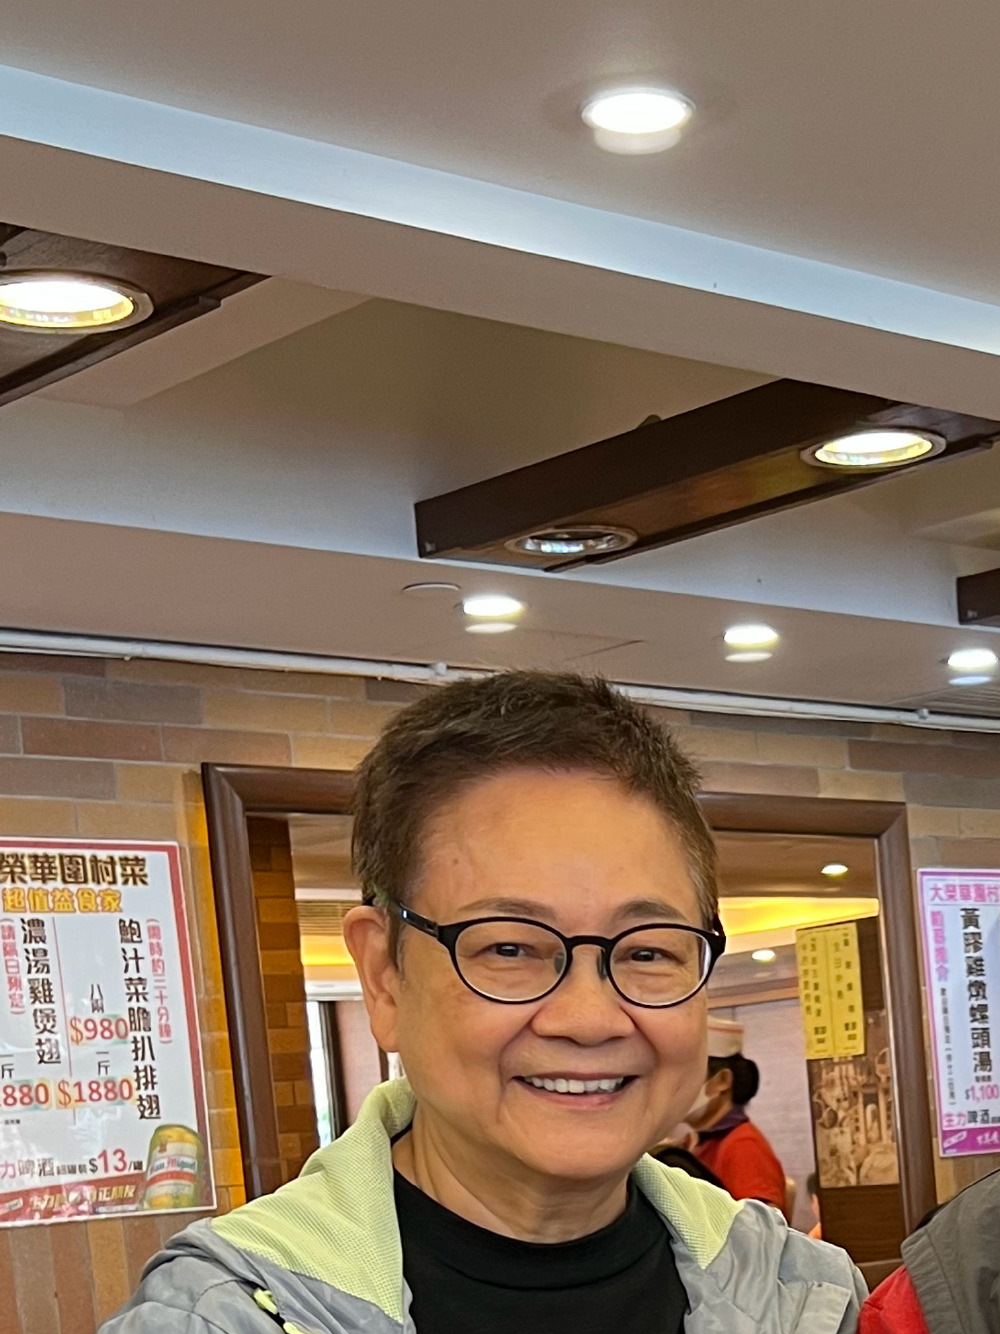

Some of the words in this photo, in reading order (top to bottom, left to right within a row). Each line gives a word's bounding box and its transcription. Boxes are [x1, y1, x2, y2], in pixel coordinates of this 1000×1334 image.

[2, 886, 123, 914] 超值益食家
[20, 917, 62, 1065] 濃湯雞煲翅
[69, 1015, 130, 1046] $980
[0, 1081, 50, 1108] 880
[57, 1078, 134, 1108] $1880
